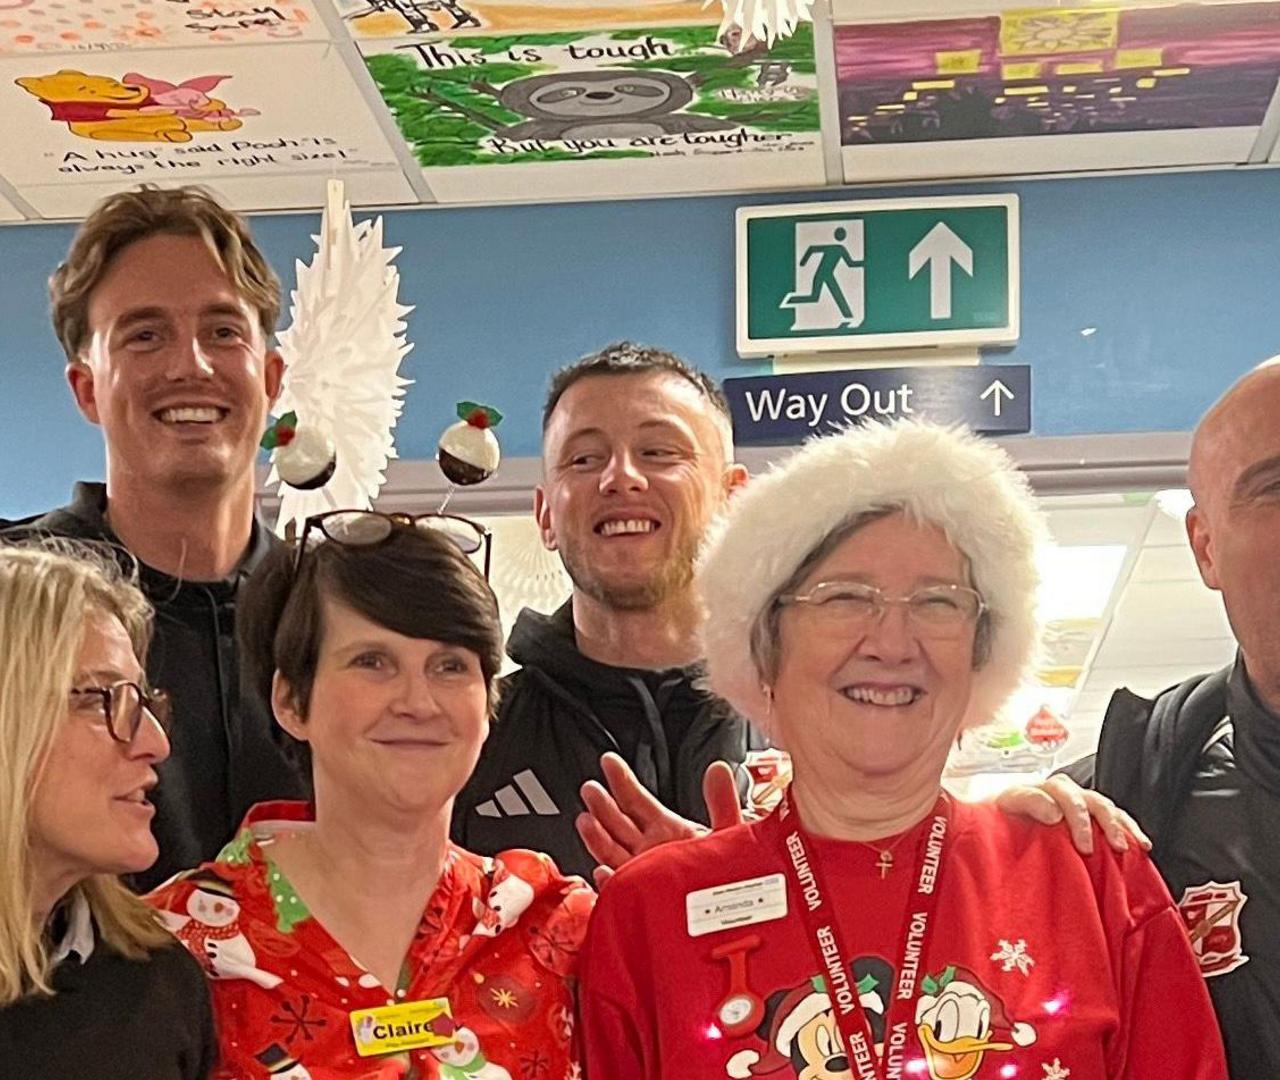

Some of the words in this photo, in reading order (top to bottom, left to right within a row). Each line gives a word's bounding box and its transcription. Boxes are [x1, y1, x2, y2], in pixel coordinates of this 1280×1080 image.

[393, 40, 487, 68] This
[507, 48, 543, 62] is
[174, 143, 223, 155] said
[487, 138, 554, 154] But
[563, 138, 617, 156] you
[629, 135, 678, 147] are
[682, 127, 793, 148] tougher
[58, 163, 145, 175] always
[154, 160, 200, 169] the
[217, 153, 277, 167] right
[745, 388, 828, 426] Way
[840, 383, 913, 416] Out
[785, 831, 823, 911] VOLUNTEER
[917, 815, 948, 895] VOLUNTEER
[815, 925, 856, 1015] VOLUNTEER
[896, 911, 928, 1000] VOLUNTEER
[372, 1021, 435, 1040] Claire
